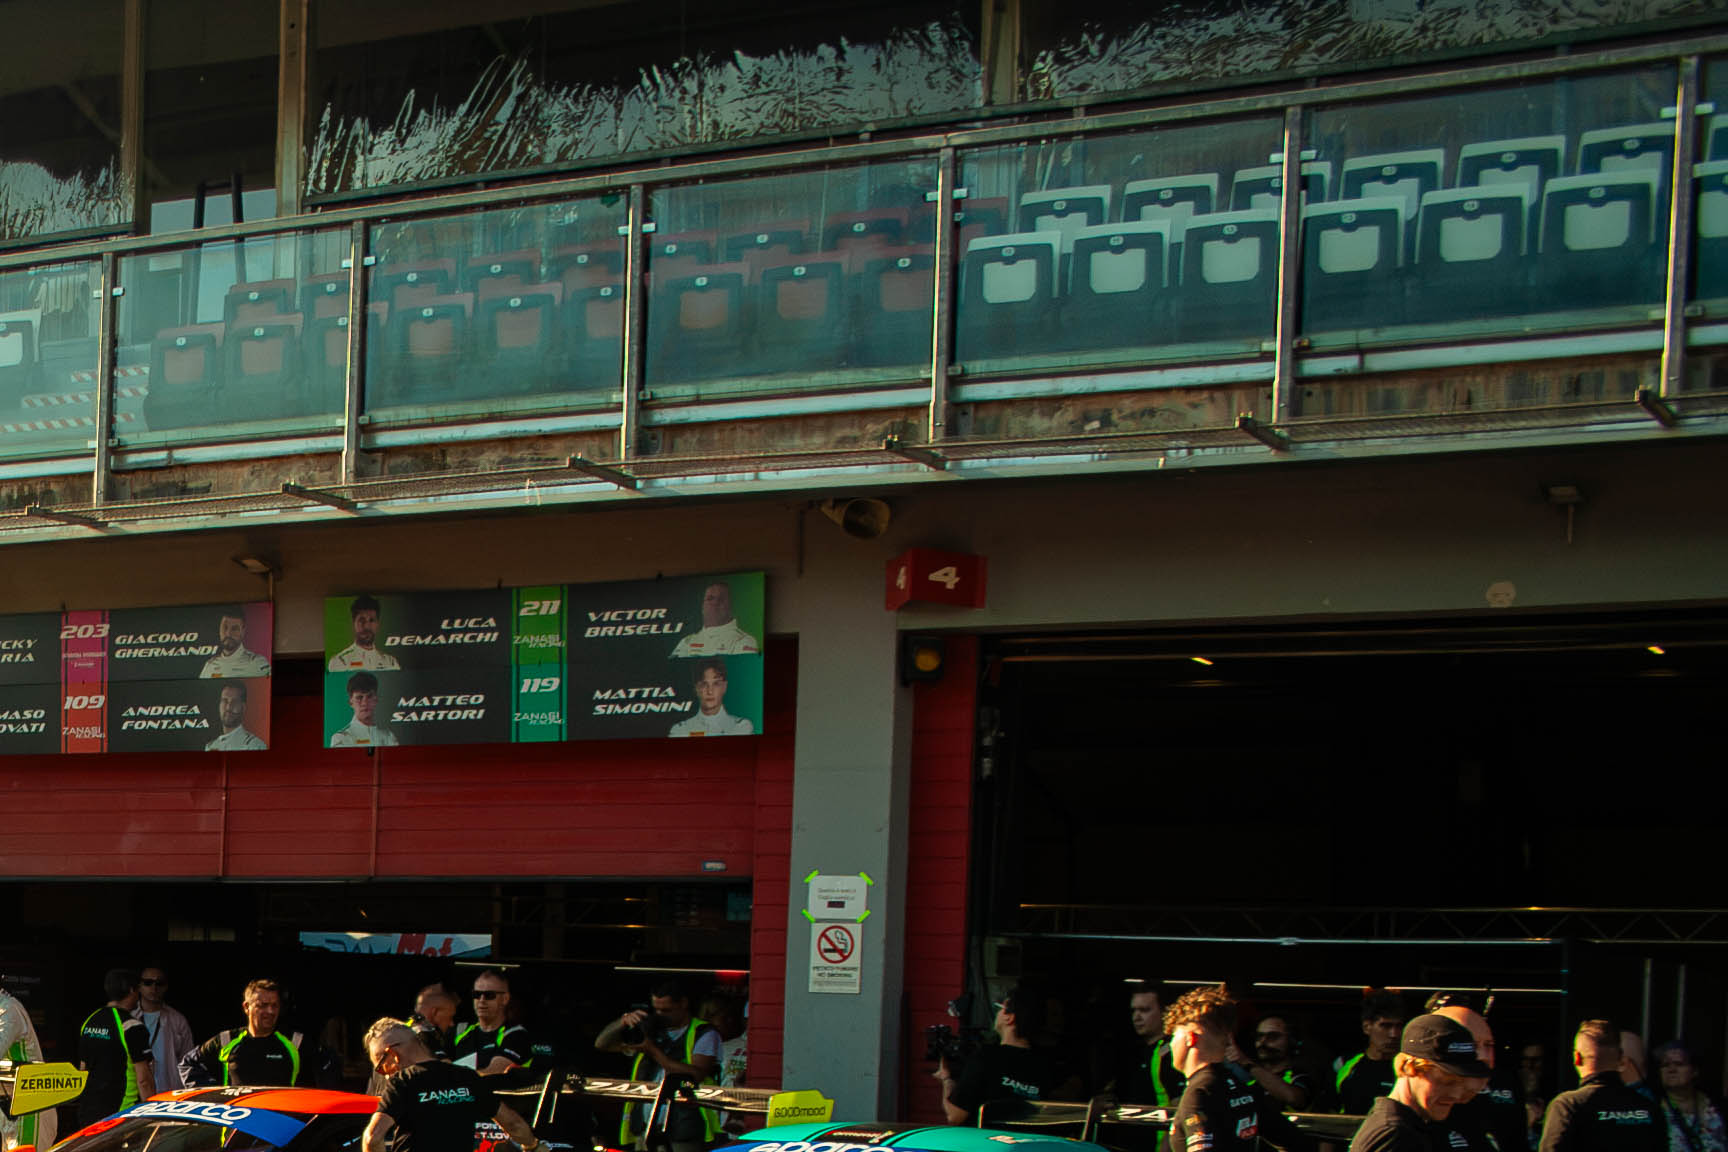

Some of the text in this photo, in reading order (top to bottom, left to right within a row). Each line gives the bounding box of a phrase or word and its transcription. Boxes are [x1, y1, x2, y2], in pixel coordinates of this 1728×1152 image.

[928, 566, 961, 590] 4
[519, 600, 561, 616] 211
[588, 608, 668, 622] VICTOR
[441, 617, 497, 630] LUCA
[584, 622, 684, 638] BRISELLI
[60, 624, 110, 640] 203
[115, 632, 199, 645] GIACOMO
[384, 631, 499, 647] DEMARCHI
[114, 645, 218, 659] GHERMANDI
[520, 677, 561, 693] 119
[397, 694, 485, 707] MATTEO
[592, 686, 676, 701] MATTIA
[63, 695, 106, 710] 109
[592, 700, 693, 716] SIMONINI
[122, 704, 201, 717] ANDREA
[390, 708, 486, 723] SARTORI
[122, 718, 210, 730] FONTANA
[20, 1076, 83, 1090] ZERBINATI
[418, 1087, 470, 1103] ZANASI
[130, 1100, 252, 1122] sparco
